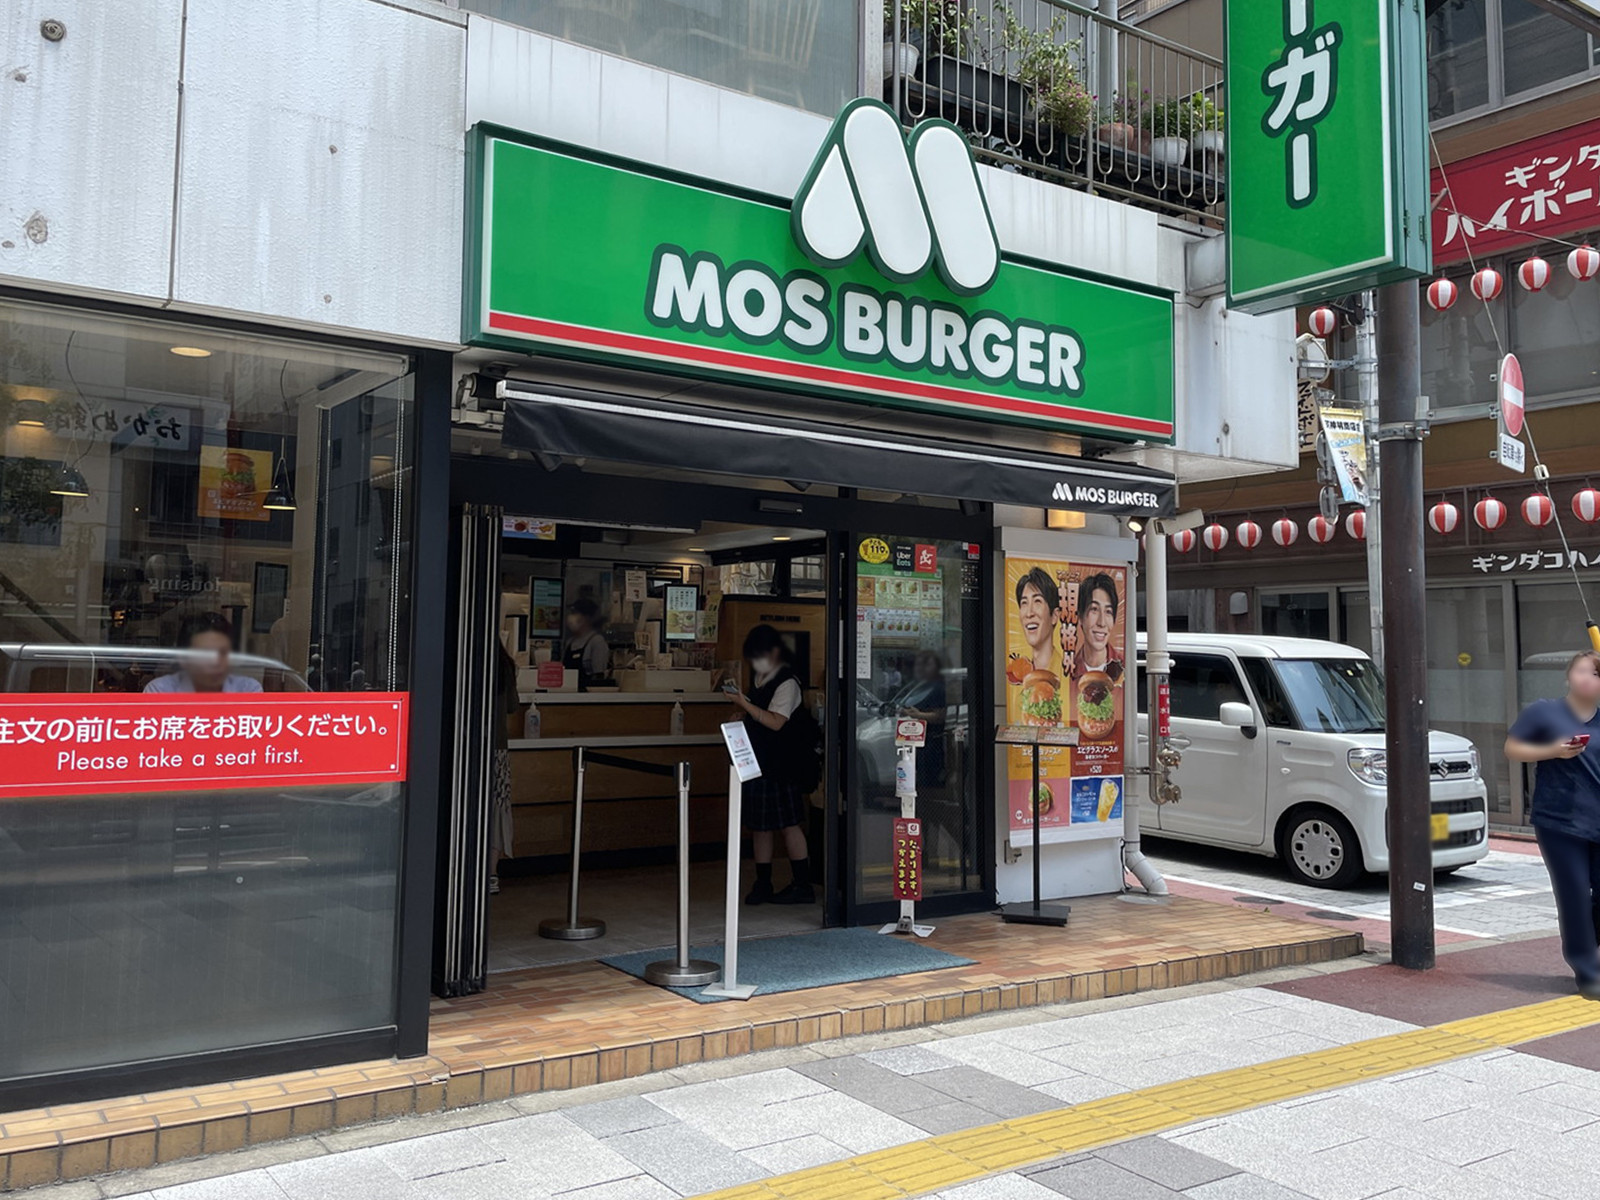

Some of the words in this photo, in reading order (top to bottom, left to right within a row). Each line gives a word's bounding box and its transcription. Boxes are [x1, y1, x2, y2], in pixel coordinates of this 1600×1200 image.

[1442, 177, 1600, 247] ハイボー
[651, 251, 829, 348] MOS
[842, 291, 1082, 392] BURGER
[1075, 486, 1106, 504] MOS
[1107, 490, 1159, 508] BURGER
[57, 750, 128, 772] Please
[139, 747, 183, 768] take
[192, 754, 206, 767] a
[215, 749, 256, 766] seat
[264, 745, 303, 764] first.
